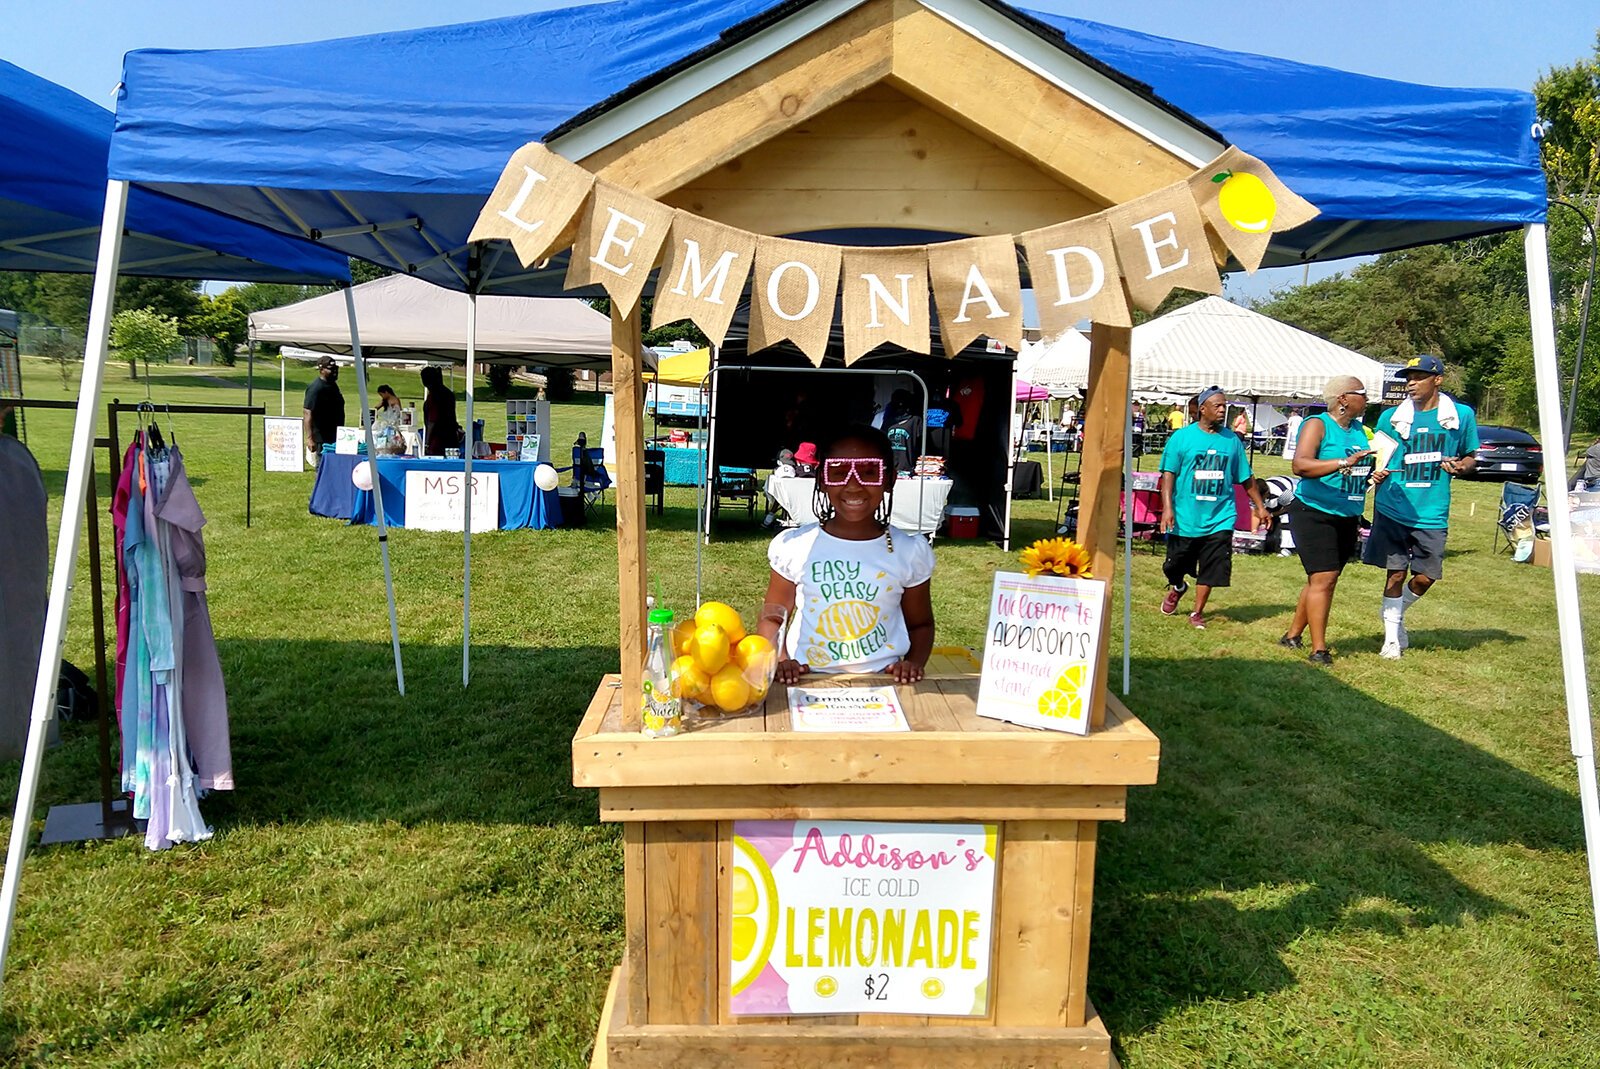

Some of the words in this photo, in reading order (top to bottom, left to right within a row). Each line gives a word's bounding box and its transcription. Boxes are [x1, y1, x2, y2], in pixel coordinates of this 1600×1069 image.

[498, 164, 1190, 328] LEMONADE
[424, 475, 479, 496] MSR
[811, 559, 861, 583] EASY
[820, 581, 880, 603] PEASY
[997, 593, 1070, 623] Welcome
[1075, 601, 1093, 626] to
[821, 602, 878, 640] LEMON
[827, 623, 888, 662] SQUEEZY
[992, 621, 1091, 659] ADDISON'S
[793, 827, 985, 873] Addison's
[842, 877, 871, 897] ICE
[877, 878, 920, 898] COLD
[785, 906, 981, 970] LEMONADE
[863, 973, 890, 1001] $2
